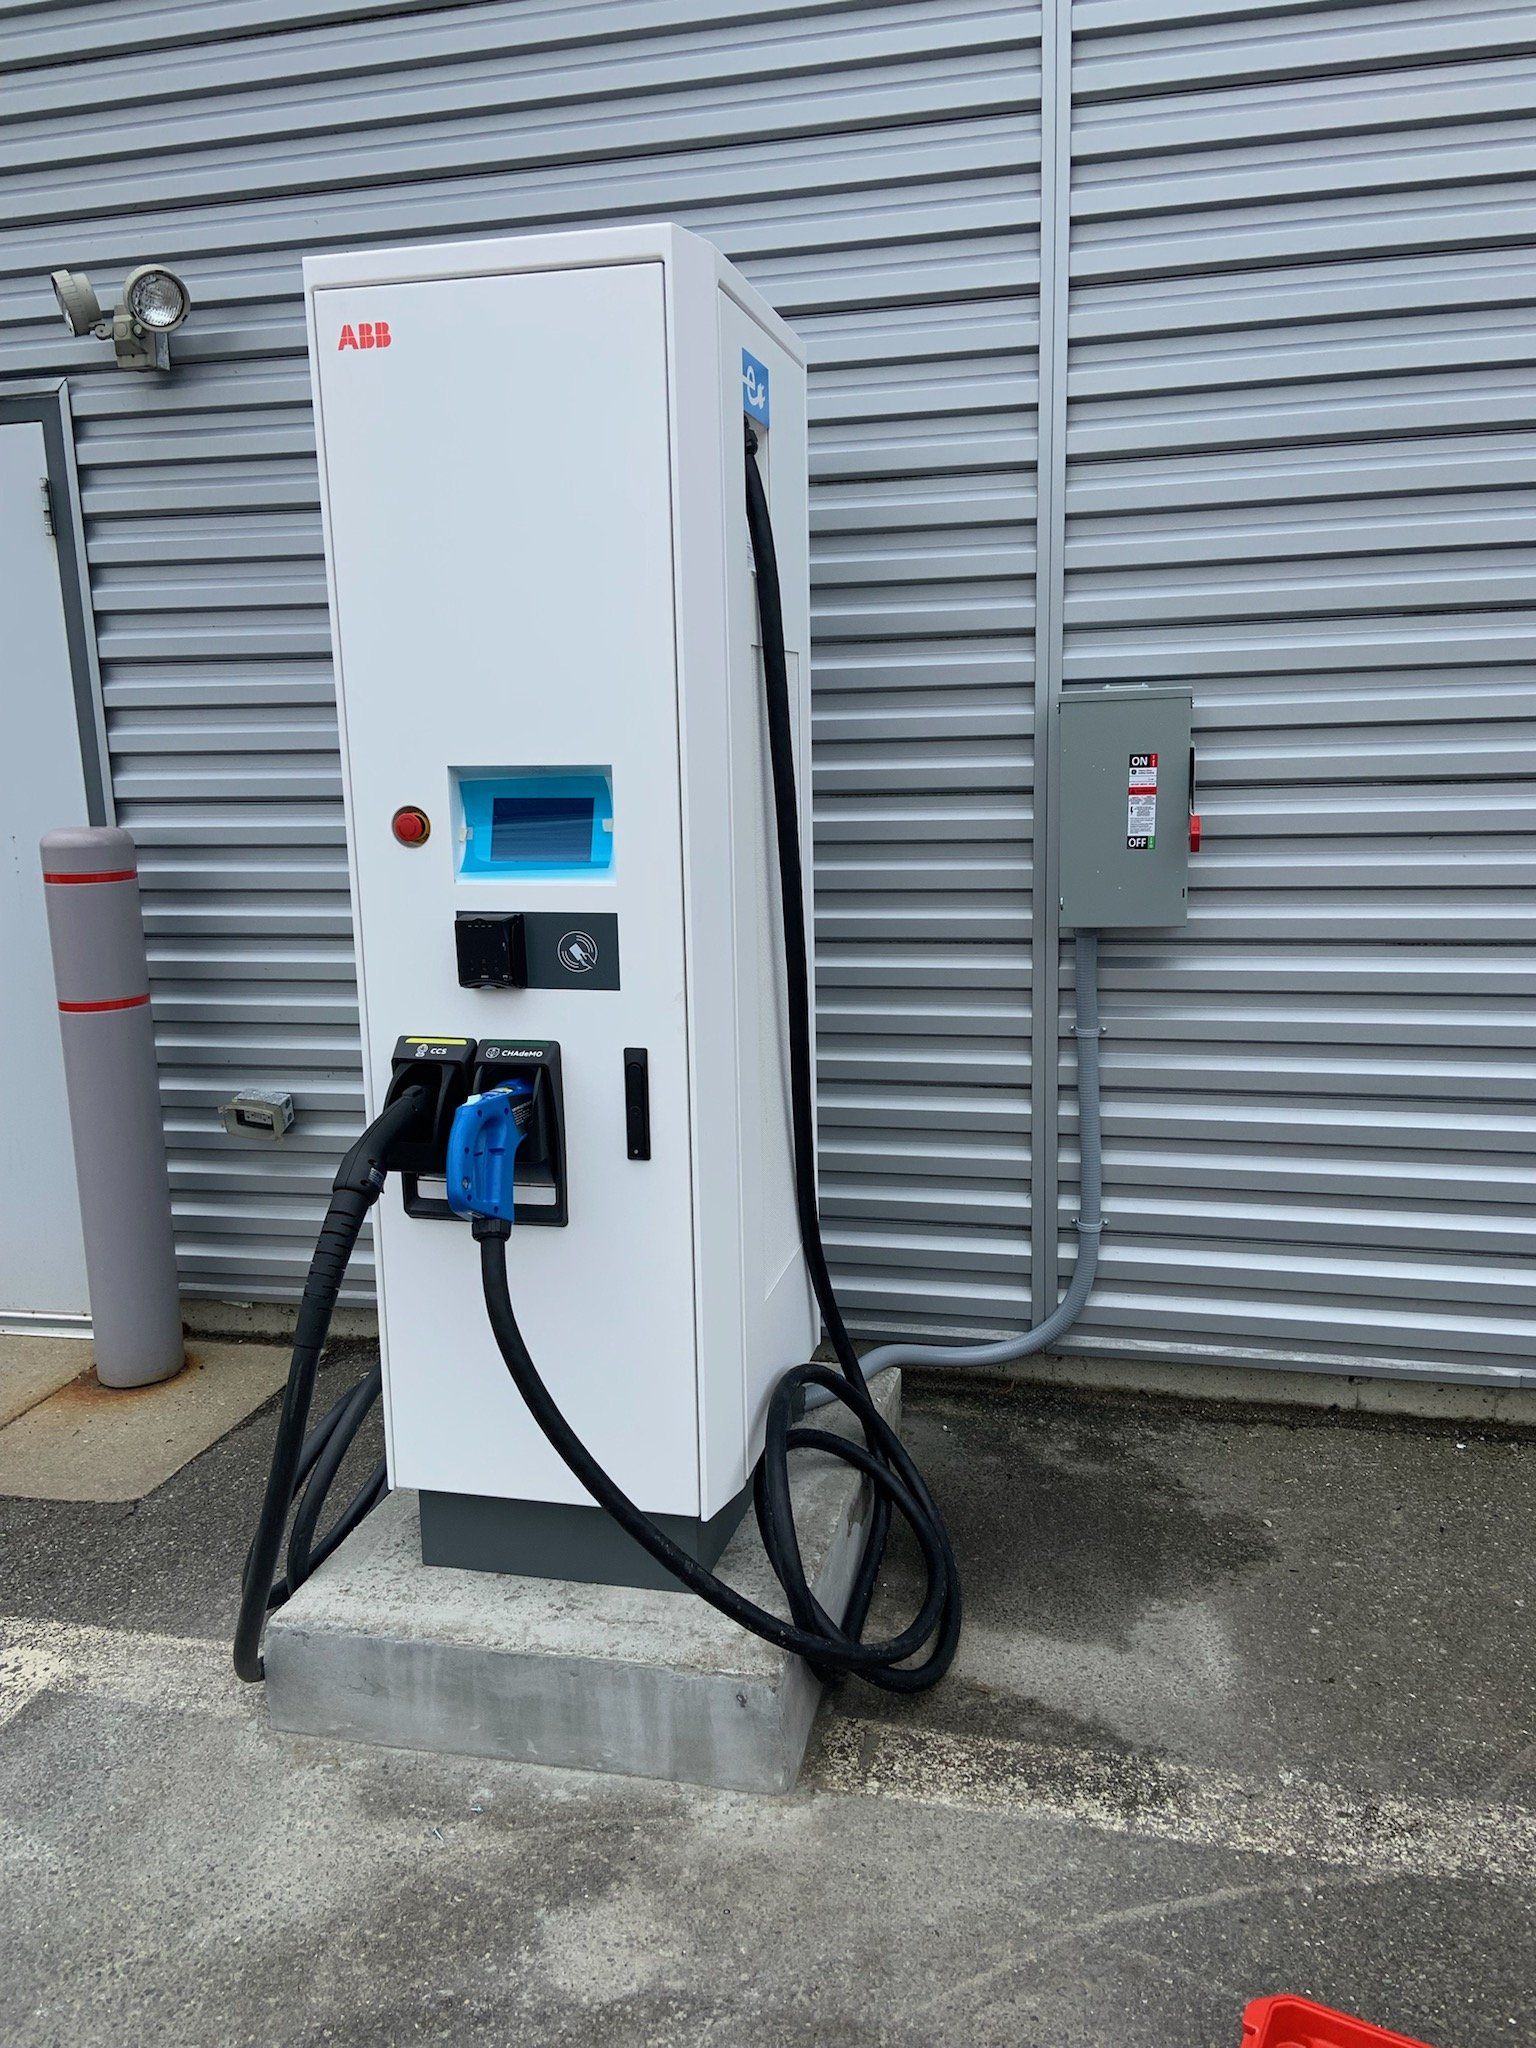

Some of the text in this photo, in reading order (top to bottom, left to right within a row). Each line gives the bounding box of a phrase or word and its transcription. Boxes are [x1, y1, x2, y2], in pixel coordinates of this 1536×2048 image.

[338, 322, 391, 351] ABB
[1131, 756, 1148, 767] ON
[1128, 838, 1147, 848] OFF
[429, 1047, 448, 1055] CCS
[501, 1049, 543, 1058] CHAdeMO
